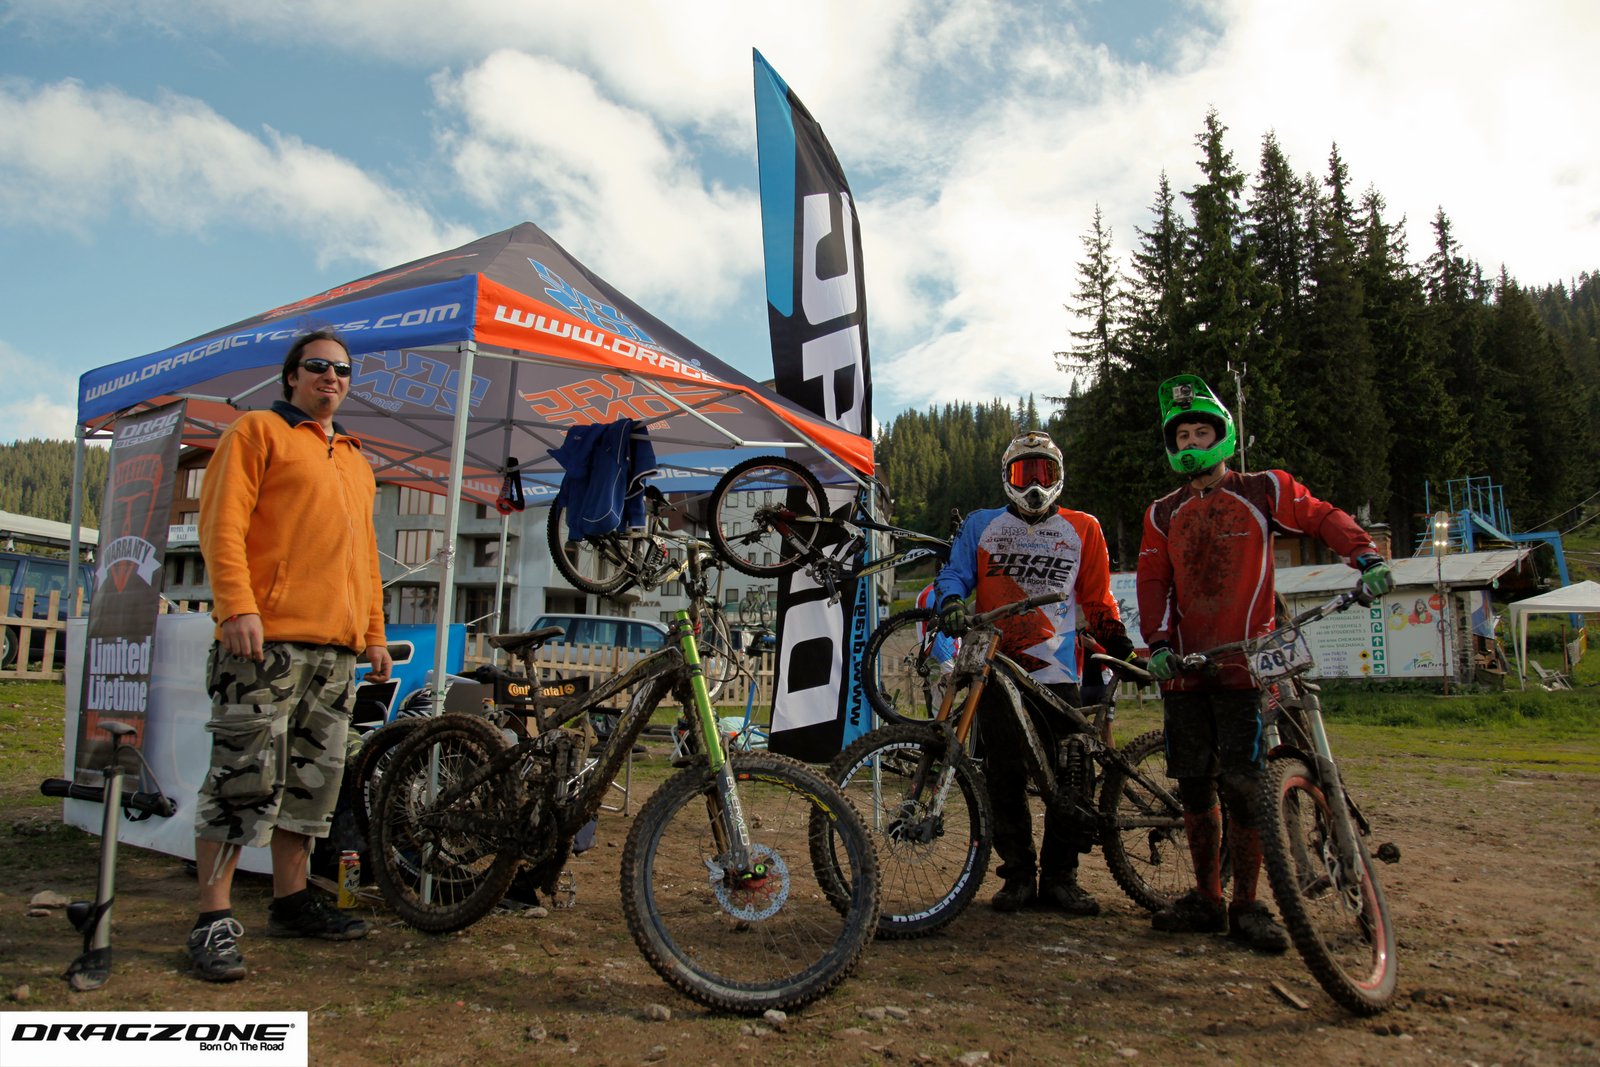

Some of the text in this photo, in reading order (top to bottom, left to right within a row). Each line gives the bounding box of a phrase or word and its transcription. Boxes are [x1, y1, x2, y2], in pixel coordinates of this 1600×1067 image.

[119, 410, 181, 440] DRAG
[104, 540, 151, 570] WARRANTY
[987, 553, 1075, 571] DRAG
[985, 565, 1069, 582] ZONE
[90, 636, 151, 675] Limited
[1260, 645, 1296, 671] 407
[87, 676, 147, 713] Lifetime
